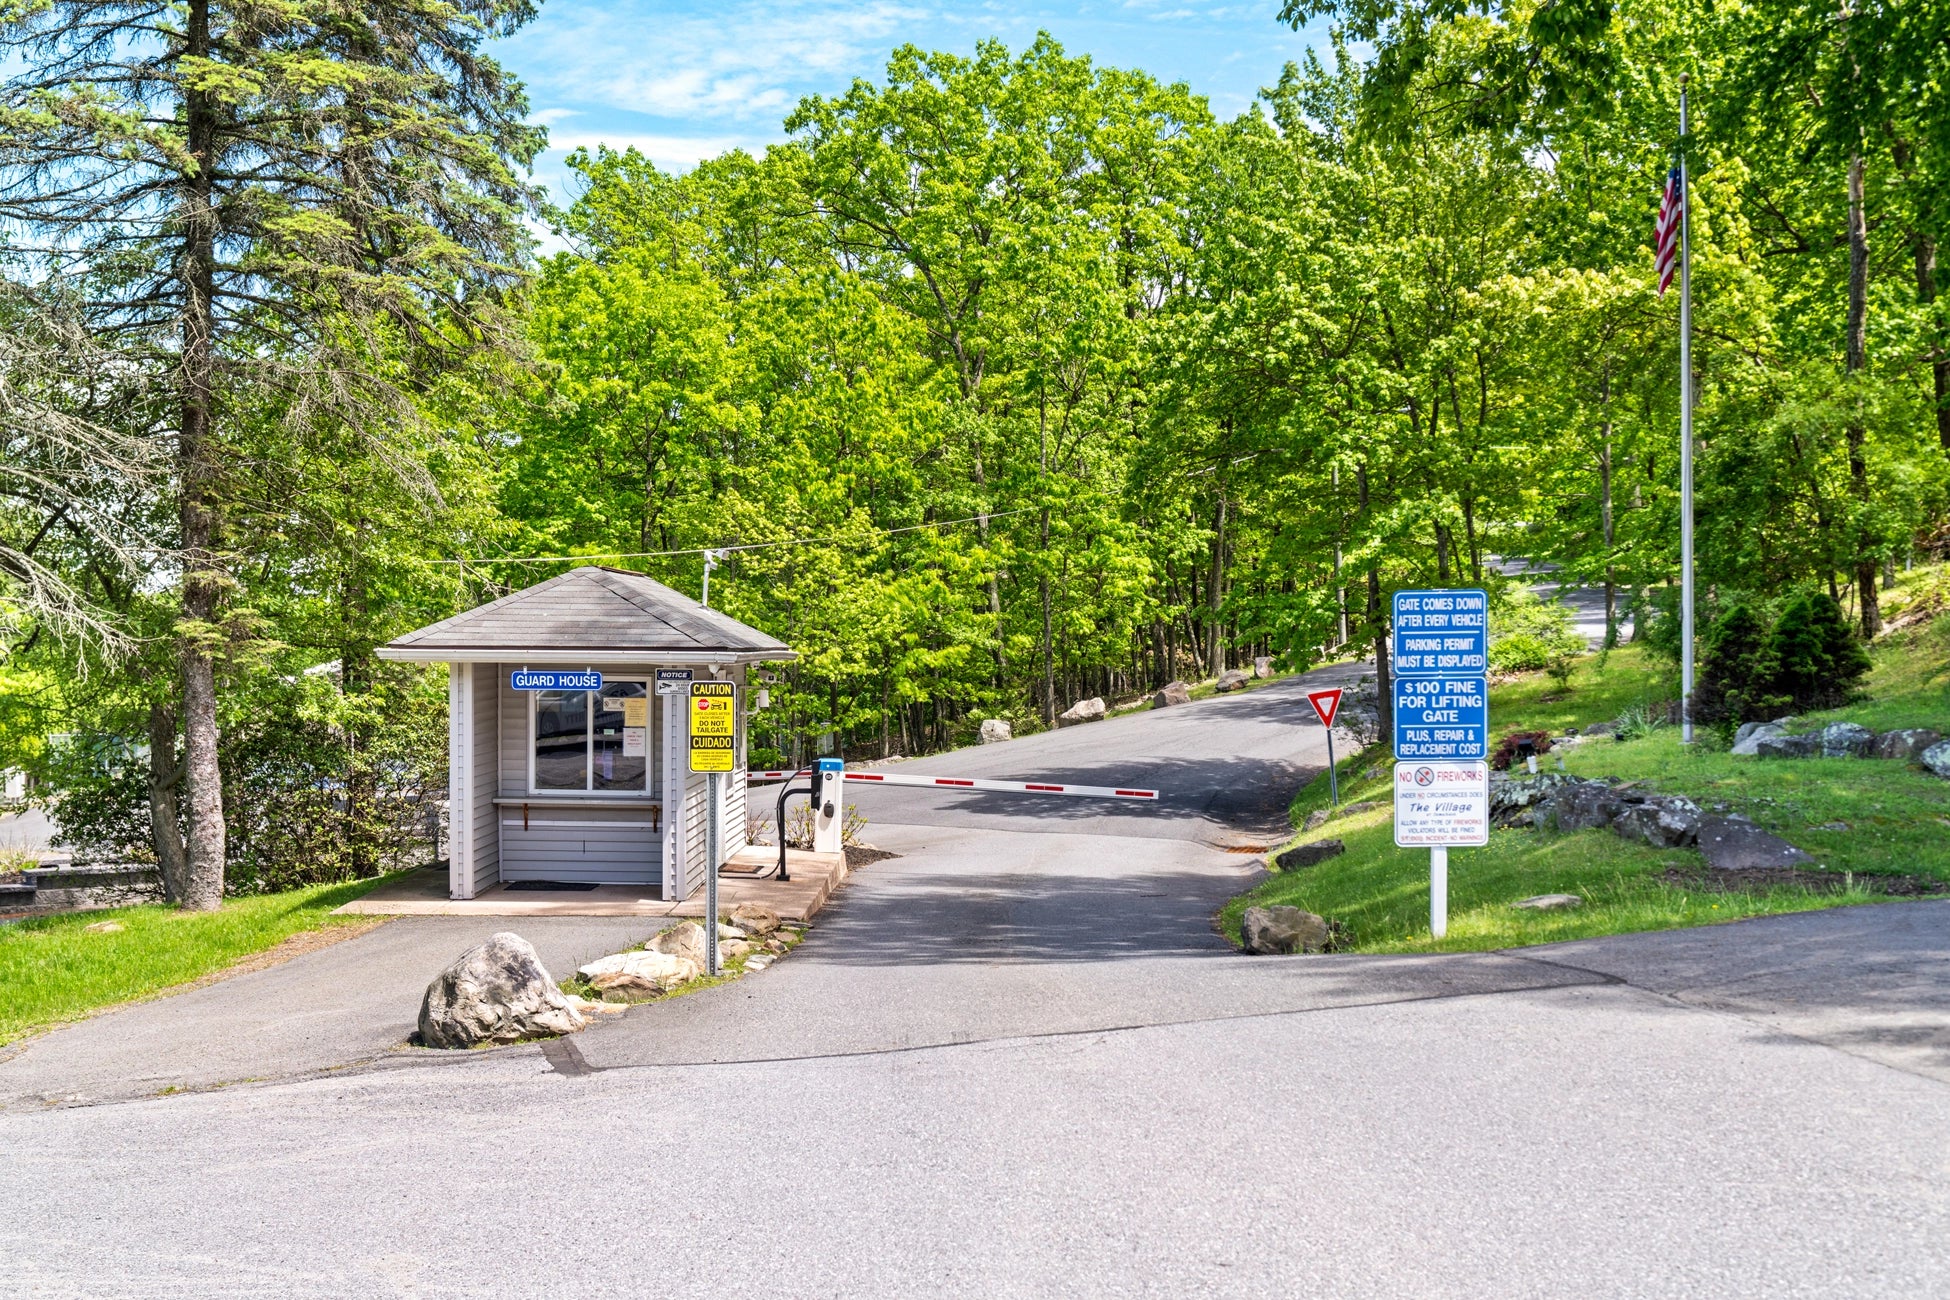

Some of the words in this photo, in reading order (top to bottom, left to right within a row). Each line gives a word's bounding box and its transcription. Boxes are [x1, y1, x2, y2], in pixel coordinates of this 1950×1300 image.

[1399, 599, 1420, 610] GATE
[1423, 598, 1453, 610] COMES
[1456, 598, 1482, 610] DOWN
[1398, 615, 1422, 627] AFTER
[1425, 614, 1449, 626] EVERY
[1451, 614, 1482, 626] VEHICLE
[1406, 638, 1441, 651] PARKING
[1444, 638, 1475, 650] PERMIT
[1398, 656, 1421, 667] MUST
[1424, 655, 1435, 667] BE
[1438, 655, 1482, 667] DISPLAYED
[516, 675, 554, 686] GUARD
[560, 676, 597, 686] HOUSE
[694, 684, 731, 695] CAUTION
[1405, 681, 1439, 694] $100
[1445, 681, 1476, 693] FINE
[1399, 696, 1426, 708] FOR
[1432, 695, 1482, 708] LIFTING
[1422, 710, 1459, 722] GATE
[693, 737, 731, 747] CUIDADO
[1406, 730, 1431, 743] PLUS,
[1434, 730, 1464, 741] REPAIR
[1467, 729, 1474, 740] &
[1400, 744, 1457, 755] REPLACEMENT
[1459, 743, 1481, 754] COST
[1399, 772, 1412, 782] NO
[1437, 771, 1483, 781] FIREWORKS
[1410, 803, 1430, 812] The
[1435, 802, 1472, 813] Village
